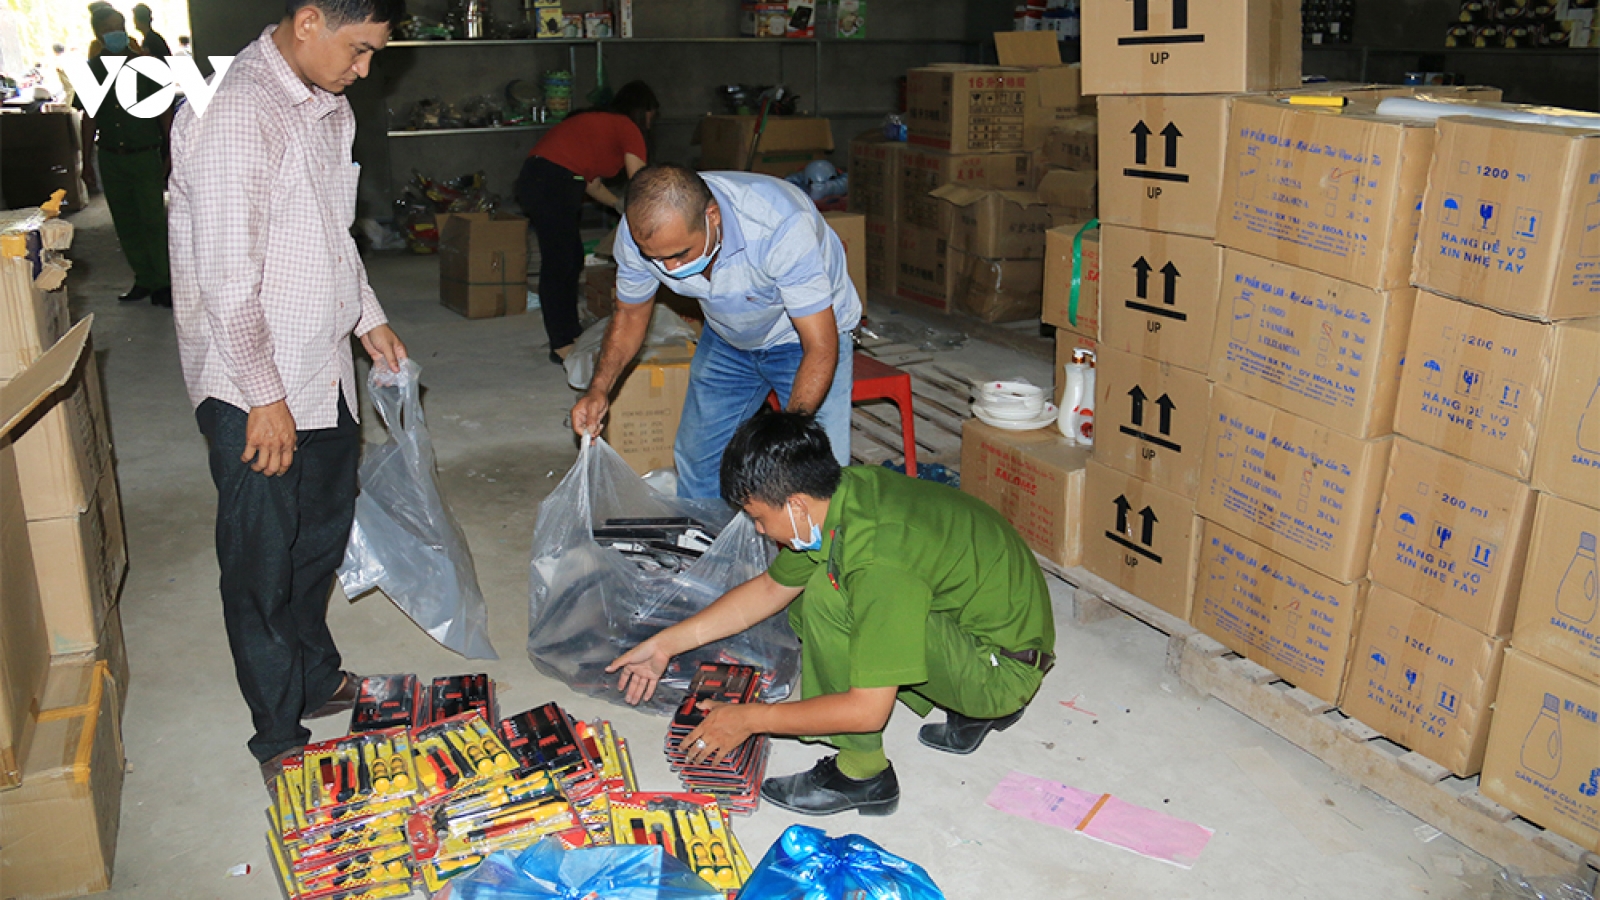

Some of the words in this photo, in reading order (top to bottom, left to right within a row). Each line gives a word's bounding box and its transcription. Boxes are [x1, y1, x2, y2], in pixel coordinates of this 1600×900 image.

[1150, 51, 1169, 65] UP
[1476, 165, 1509, 180] 1200
[1146, 186, 1162, 199] UP
[1440, 245, 1461, 259] XIN
[1497, 259, 1524, 274] TAY
[1146, 320, 1162, 333] UP
[1142, 447, 1156, 461] UP
[1435, 490, 1467, 510] 200
[1124, 553, 1139, 568] UP
[1453, 579, 1478, 596] TAY
